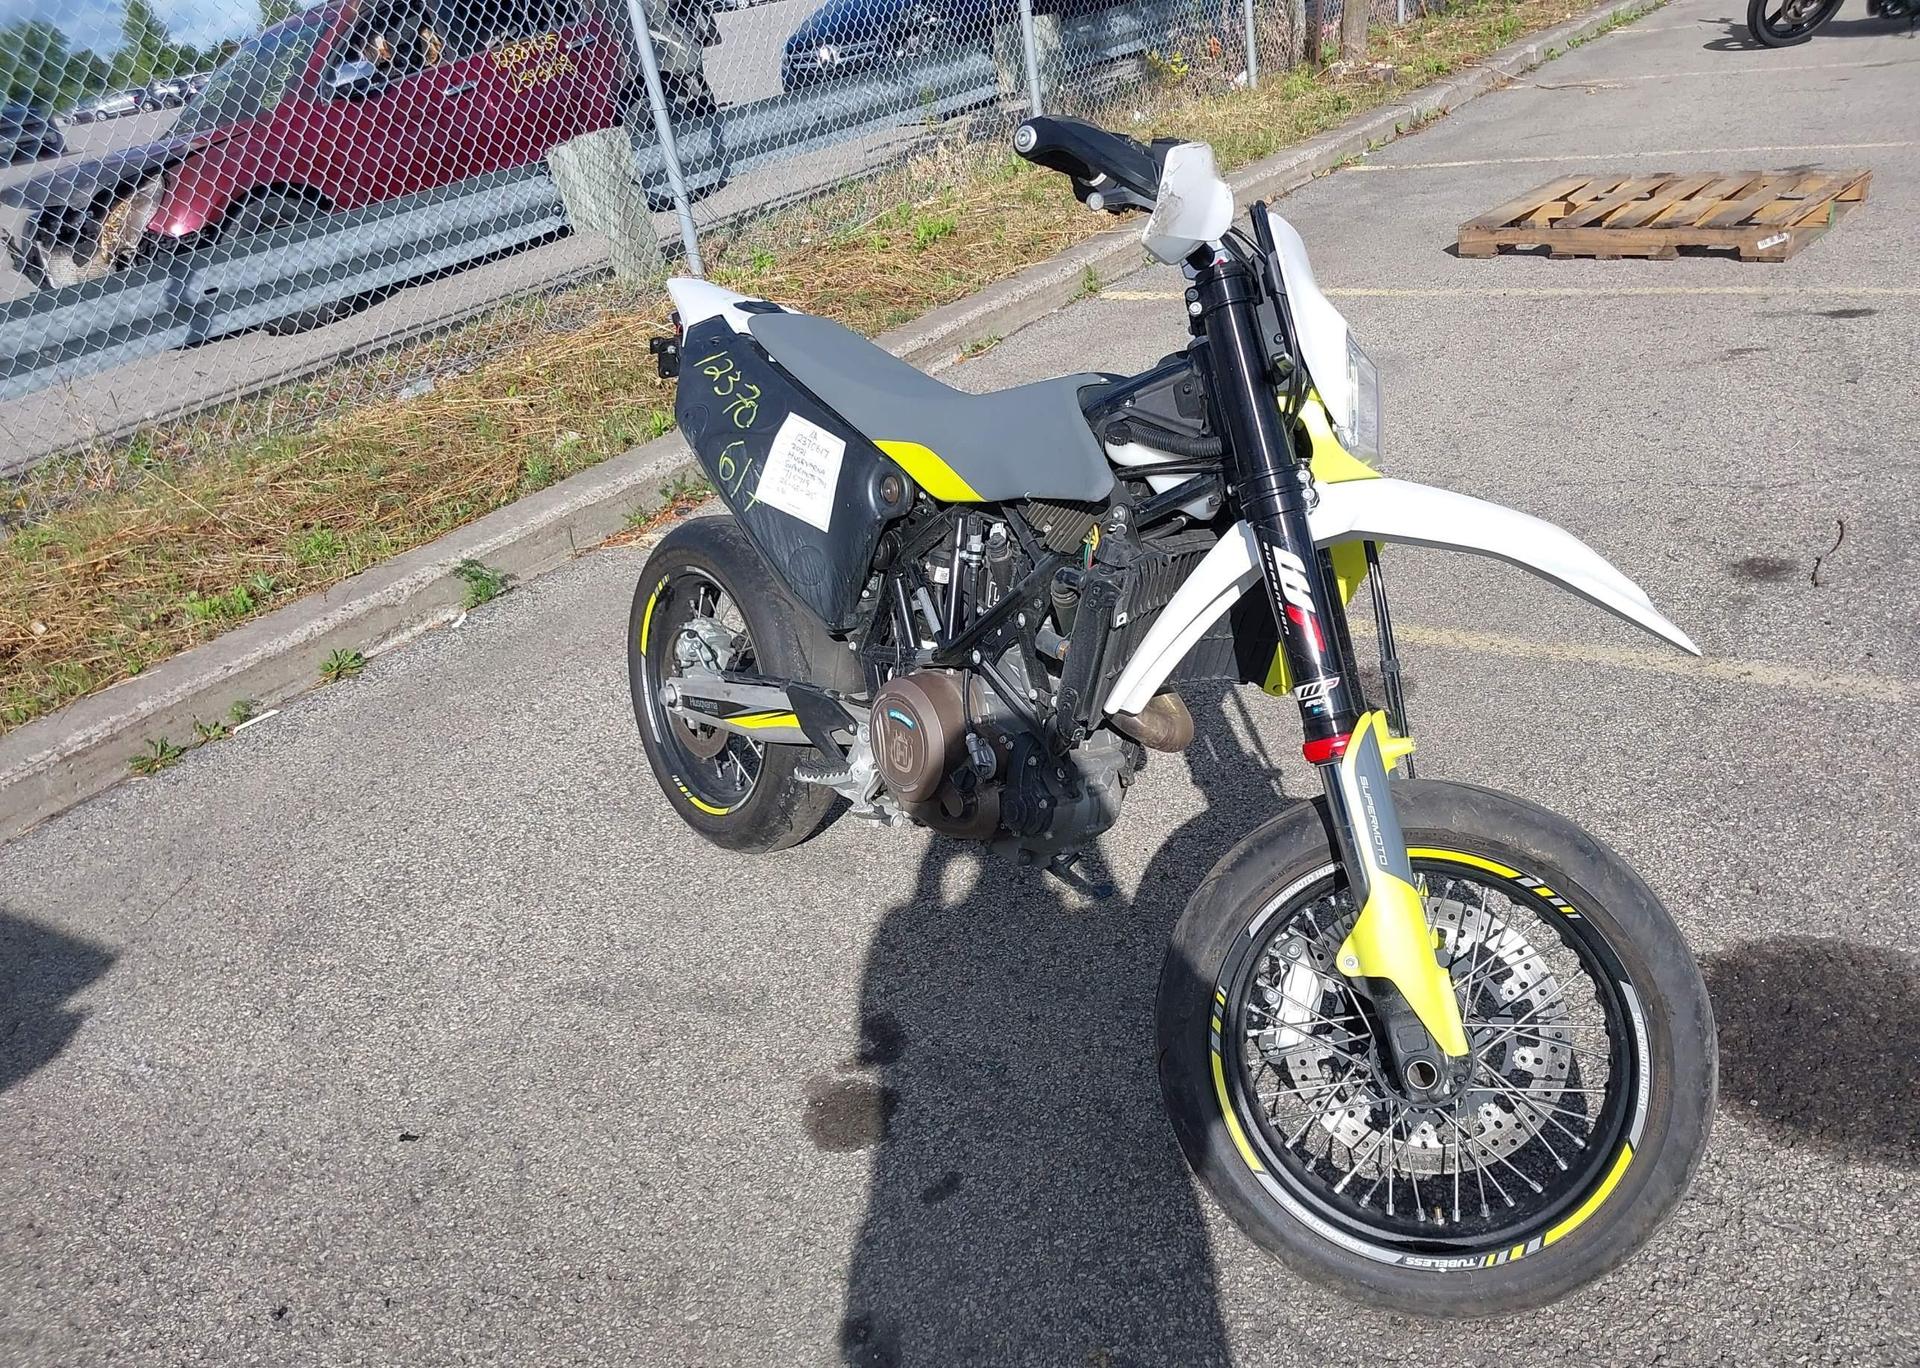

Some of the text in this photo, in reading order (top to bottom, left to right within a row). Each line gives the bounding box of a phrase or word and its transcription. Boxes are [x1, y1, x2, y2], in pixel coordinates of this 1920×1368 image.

[693, 350, 761, 428] 12370
[1296, 677, 1340, 701] WP
[1360, 775, 1389, 866] SUPERMOTO
[1266, 875, 1314, 913] SUPERMOTO
[1632, 1012, 1650, 1112] SUPERMOTO HUSKY
[1405, 1256, 1476, 1268] TUBELESS
